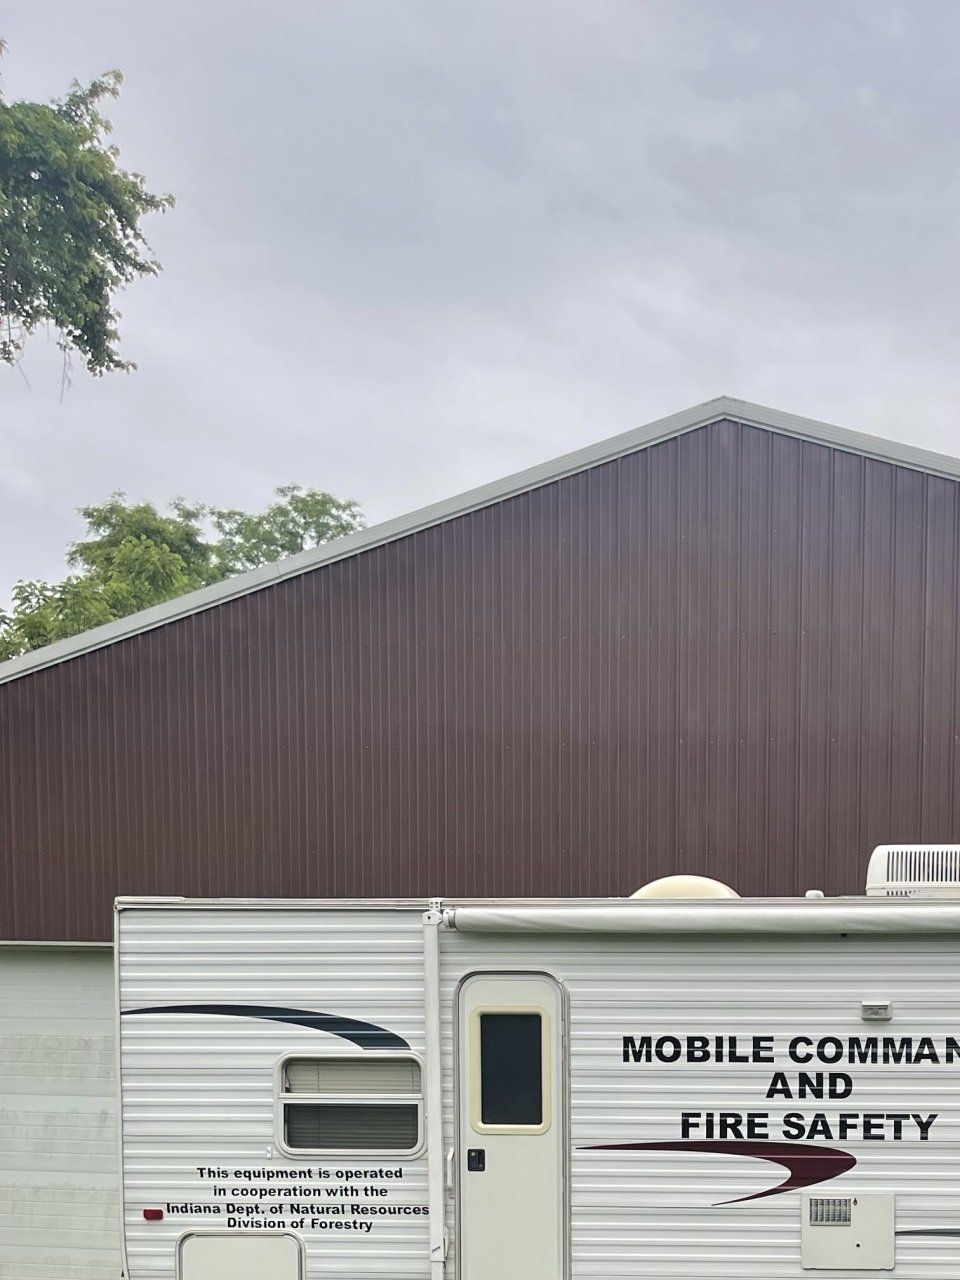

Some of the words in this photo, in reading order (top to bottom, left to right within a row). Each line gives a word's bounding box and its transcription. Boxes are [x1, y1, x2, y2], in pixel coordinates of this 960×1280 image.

[623, 1036, 774, 1063] MOBILE
[766, 1072, 853, 1099] AND
[682, 1112, 768, 1140] FIRE
[783, 1112, 938, 1141] SAFETY
[197, 1167, 229, 1179] This
[233, 1167, 313, 1182] equipment
[318, 1167, 331, 1179] is
[335, 1167, 403, 1182] operated
[213, 1185, 227, 1197] in
[231, 1185, 321, 1200] cooperation
[325, 1185, 359, 1197] with
[363, 1185, 388, 1197] the
[166, 1203, 221, 1214] Indiana
[226, 1203, 265, 1217] Dept.
[269, 1203, 285, 1215] of
[289, 1203, 345, 1215] Natural
[350, 1203, 430, 1216] Resources
[227, 1217, 286, 1229] Division
[290, 1217, 305, 1229] of
[311, 1218, 373, 1233] Forestry
